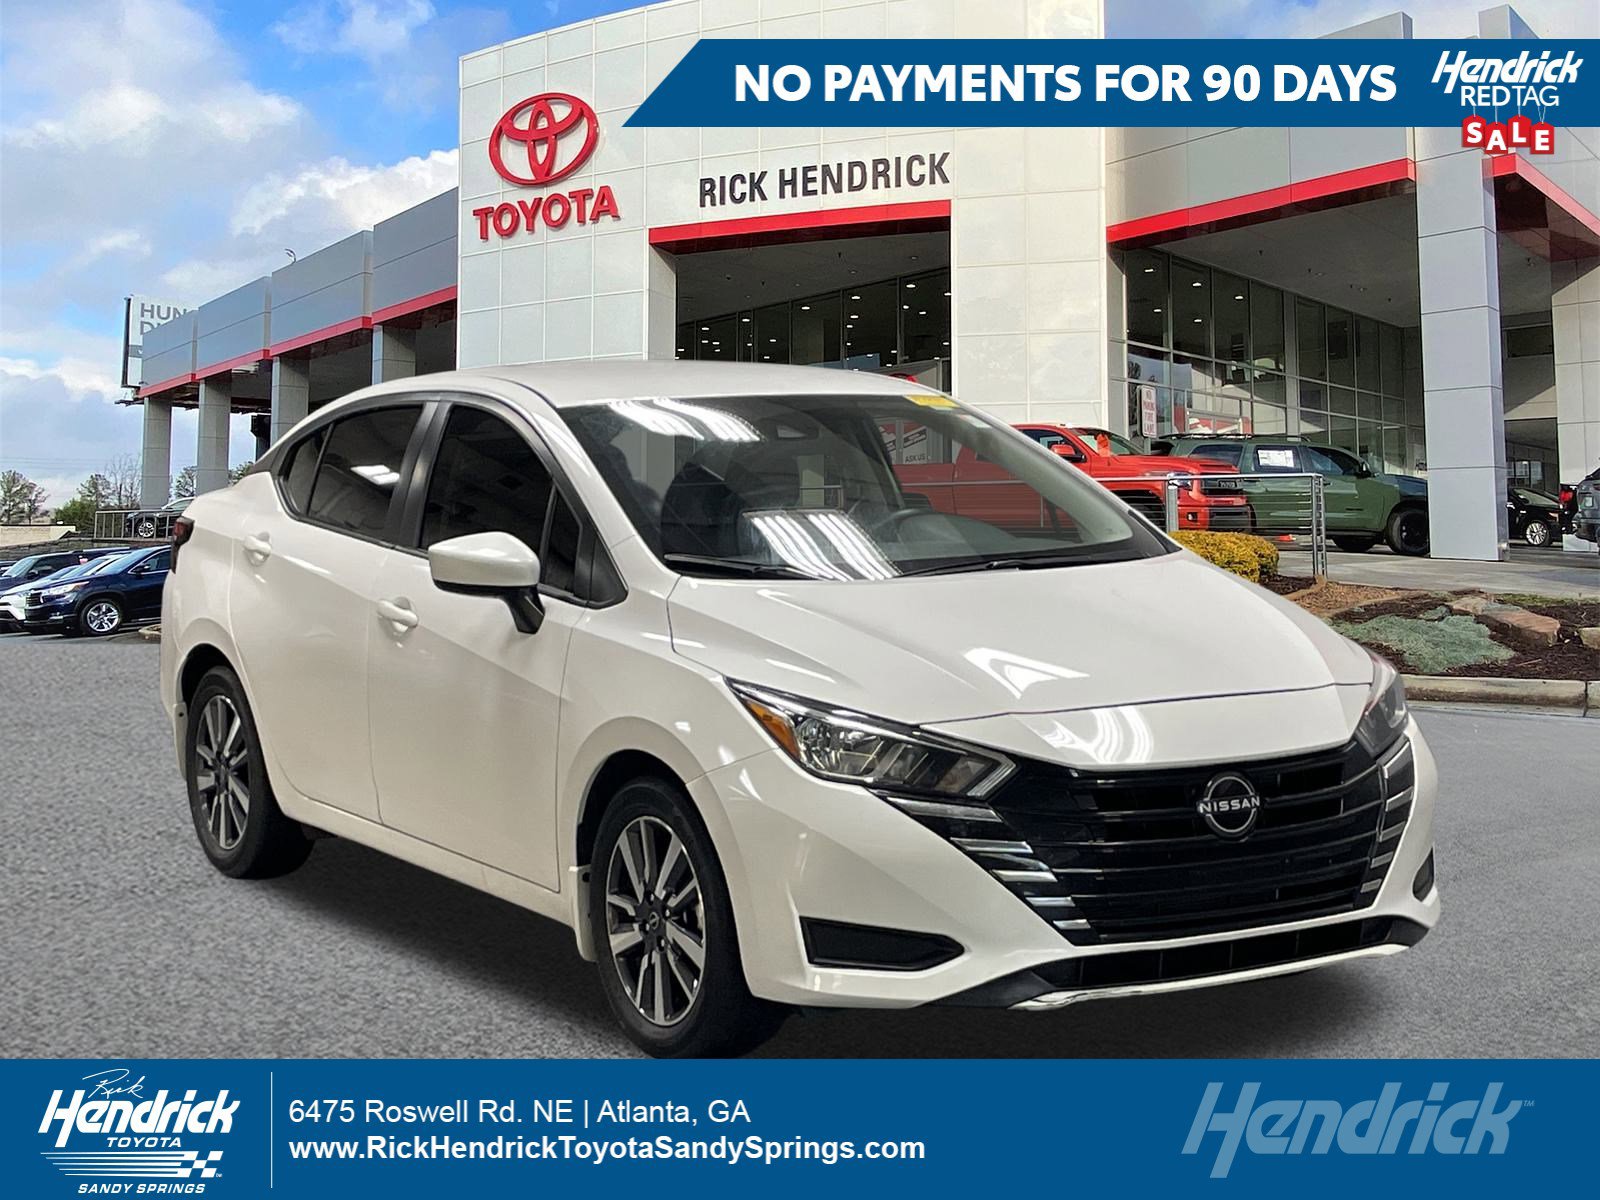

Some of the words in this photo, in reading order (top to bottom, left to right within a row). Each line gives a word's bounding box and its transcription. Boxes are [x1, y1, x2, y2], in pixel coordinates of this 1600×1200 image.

[699, 170, 769, 208] RICK
[778, 151, 951, 200] HENDRICK
[473, 185, 621, 241] TOYOTA
[1199, 796, 1260, 813] NISSAN
